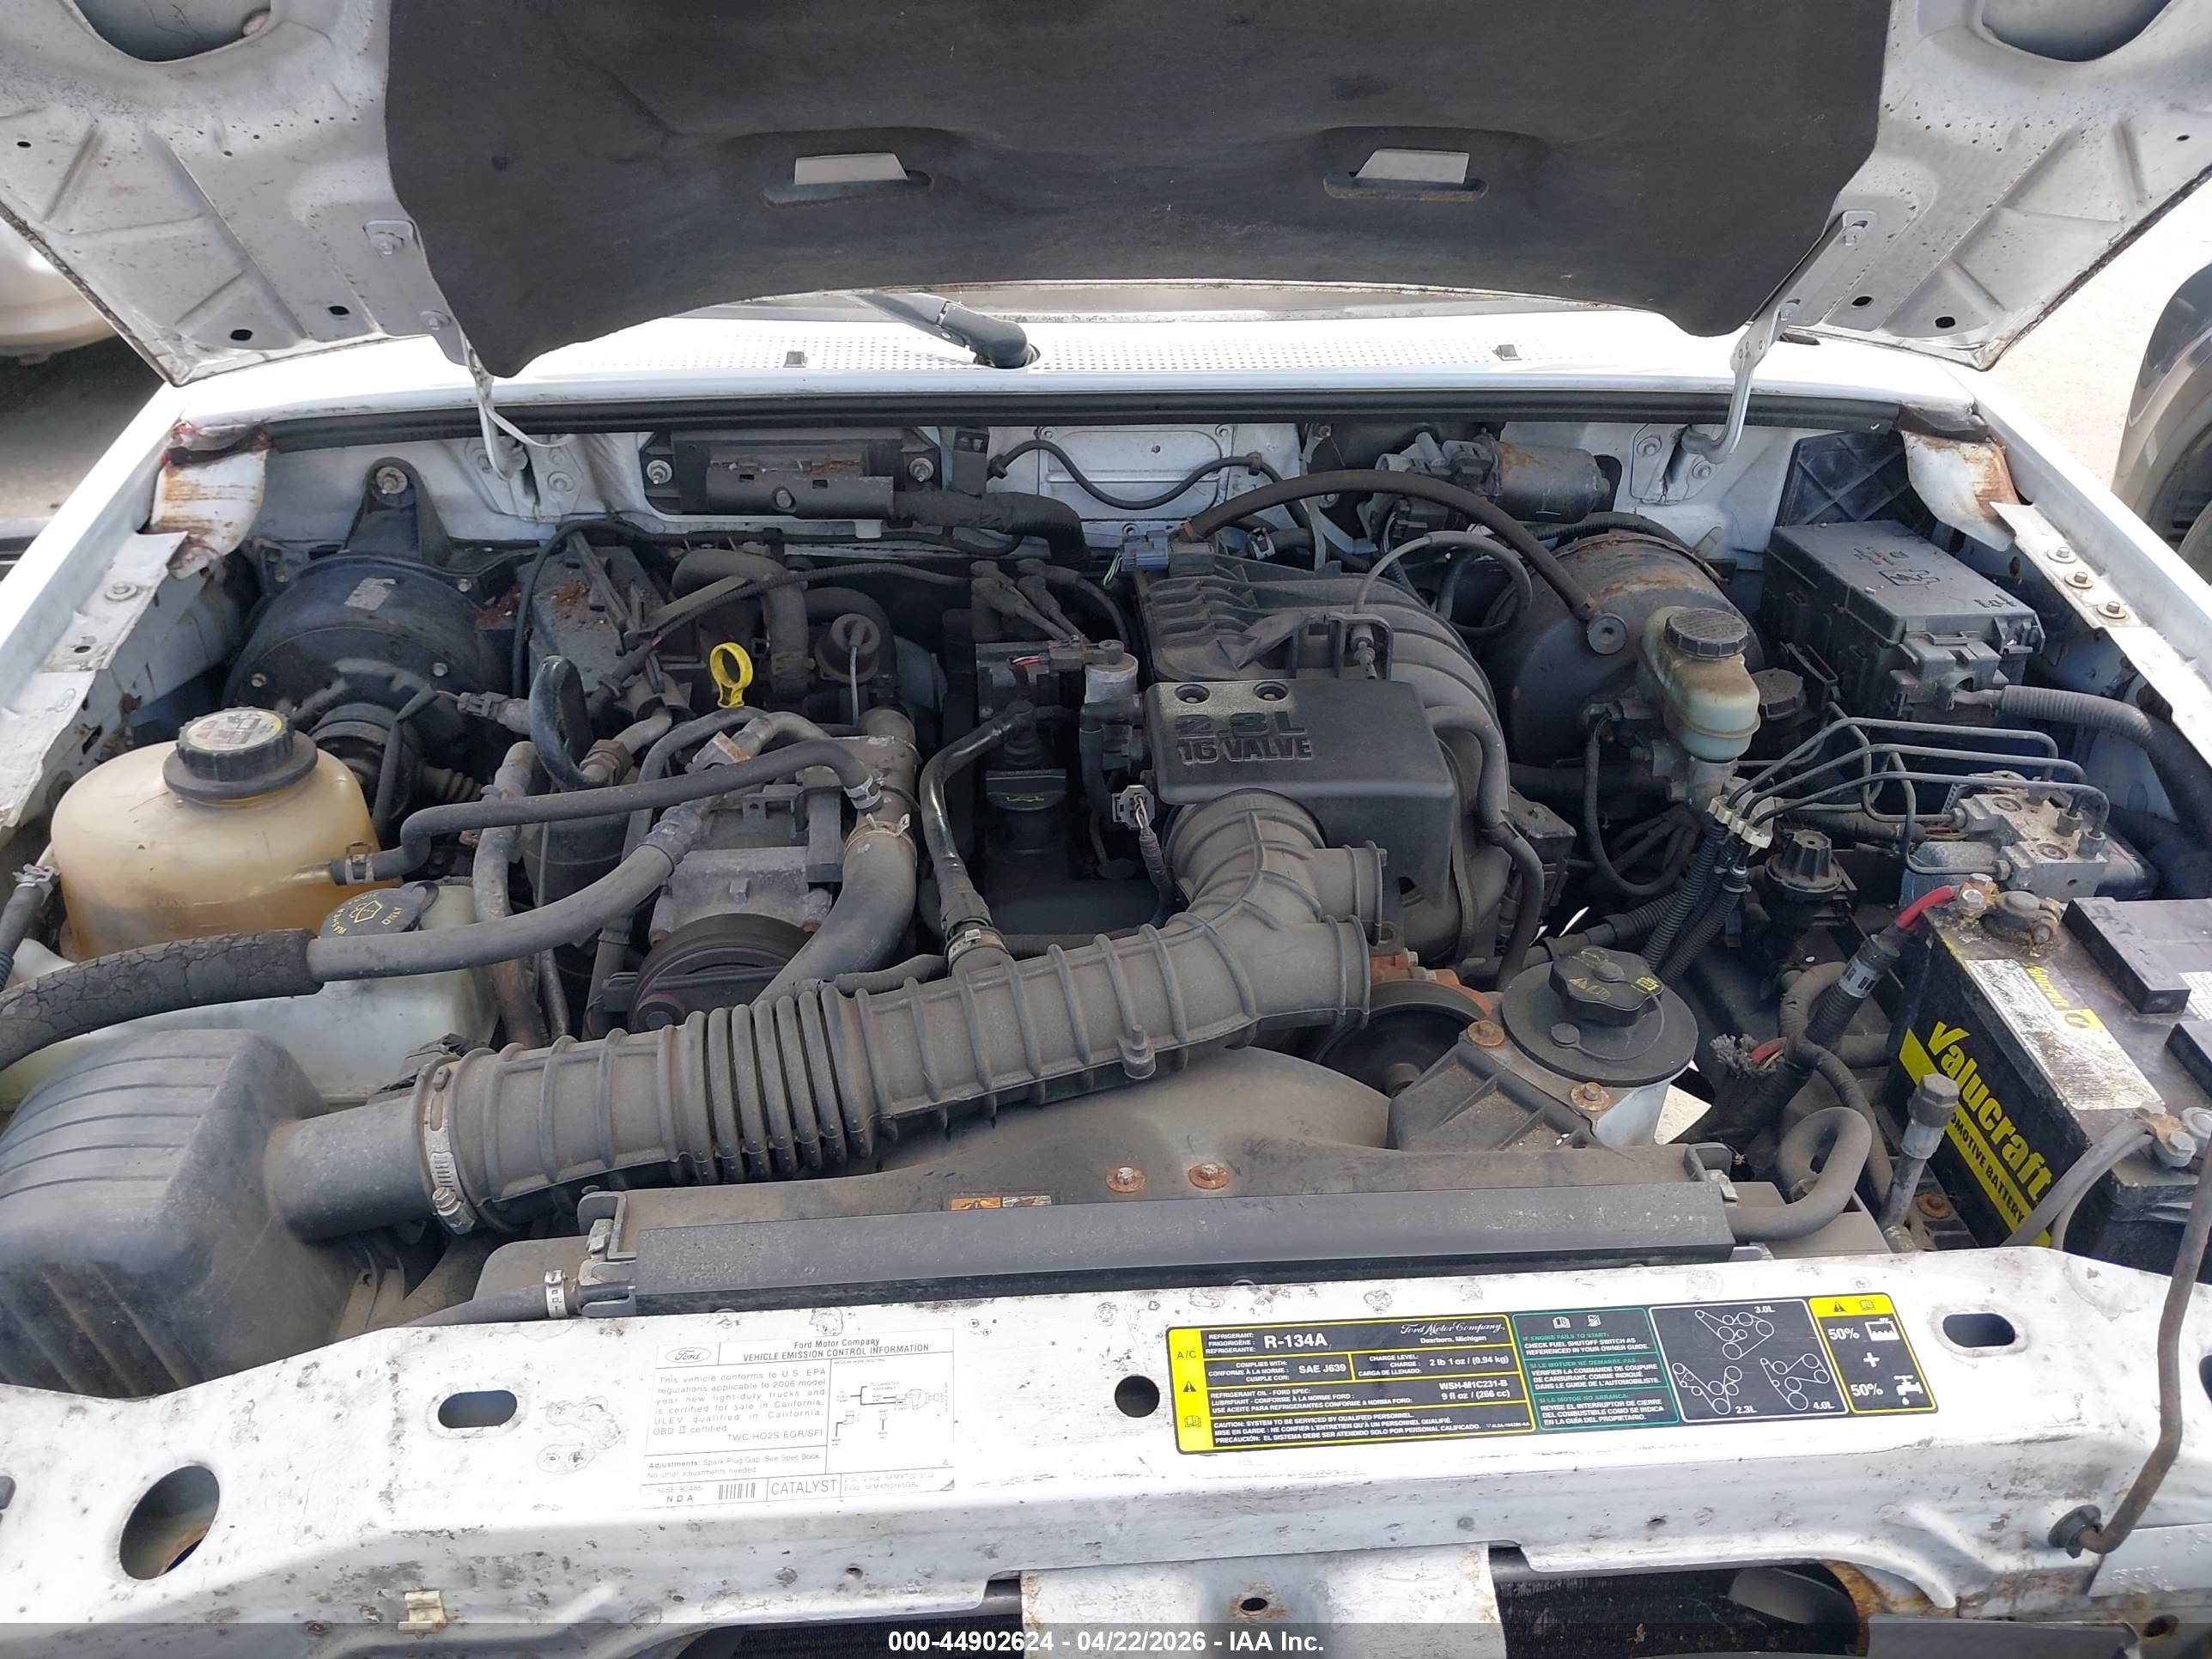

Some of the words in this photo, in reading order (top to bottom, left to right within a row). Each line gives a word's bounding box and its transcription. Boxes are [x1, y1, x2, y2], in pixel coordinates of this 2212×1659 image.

[1175, 711, 1307, 739] 2.3L
[1176, 740, 1218, 764] 16
[1224, 738, 1312, 762] VALVE
[381, 907, 404, 926] ONLY
[1928, 1021, 2052, 1202] Valucraft
[1951, 1113, 1985, 1168] OMOTIVE
[1985, 1165, 2025, 1224] BATTERY
[1753, 1304, 1776, 1313] 3.0L
[1400, 1323, 1424, 1334] Ford
[1423, 1322, 1453, 1335] Motor
[1454, 1320, 1505, 1334] Company
[1826, 1327, 1861, 1340] 50%
[793, 1340, 811, 1349] Ford
[814, 1339, 838, 1347] Motor
[842, 1336, 879, 1348] Company
[1262, 1332, 1328, 1349] R-134A
[1455, 1334, 1487, 1343] Michigan
[673, 1348, 702, 1361] Ford
[742, 1352, 779, 1362] VEHICLE
[781, 1349, 823, 1359] EMISSION
[826, 1346, 866, 1357] CONTROL
[869, 1343, 929, 1354] INFORMATION
[1176, 1349, 1196, 1359] A/C
[1525, 1347, 1571, 1356] REFERENCED
[1436, 1358, 1446, 1366] lb
[1471, 1355, 1493, 1365] (0.94
[1493, 1354, 1510, 1364] kg)
[658, 1375, 678, 1384] This
[682, 1373, 716, 1383] vehicle
[720, 1370, 763, 1381] conforms
[768, 1370, 777, 1378] to
[805, 1367, 826, 1376] EPA
[1297, 1364, 1321, 1374] SAE
[1322, 1364, 1347, 1372] J639
[656, 1384, 708, 1396] regulations
[710, 1382, 757, 1393] applicable
[761, 1381, 769, 1389] to
[772, 1380, 795, 1389] 2006
[798, 1378, 825, 1387] model
[1438, 1379, 1508, 1390] WSH-M1C231-B
[1849, 1382, 1884, 1397] 50%
[655, 1397, 678, 1406] year
[712, 1391, 762, 1403] light-duty
[769, 1389, 799, 1398] trucks
[806, 1388, 825, 1396] and
[1474, 1389, 1495, 1400] (266
[1495, 1389, 1510, 1399] cc)
[1269, 1401, 1323, 1410] REFRIGERANTES
[1734, 1404, 1758, 1414] 2.3L
[1811, 1401, 1835, 1410] 4.0L
[1213, 1420, 1245, 1429] CAUTION:
[1337, 1413, 1372, 1422] QUALIFIED
[652, 1426, 674, 1436] OBD
[770, 1479, 836, 1495] CATALYST
